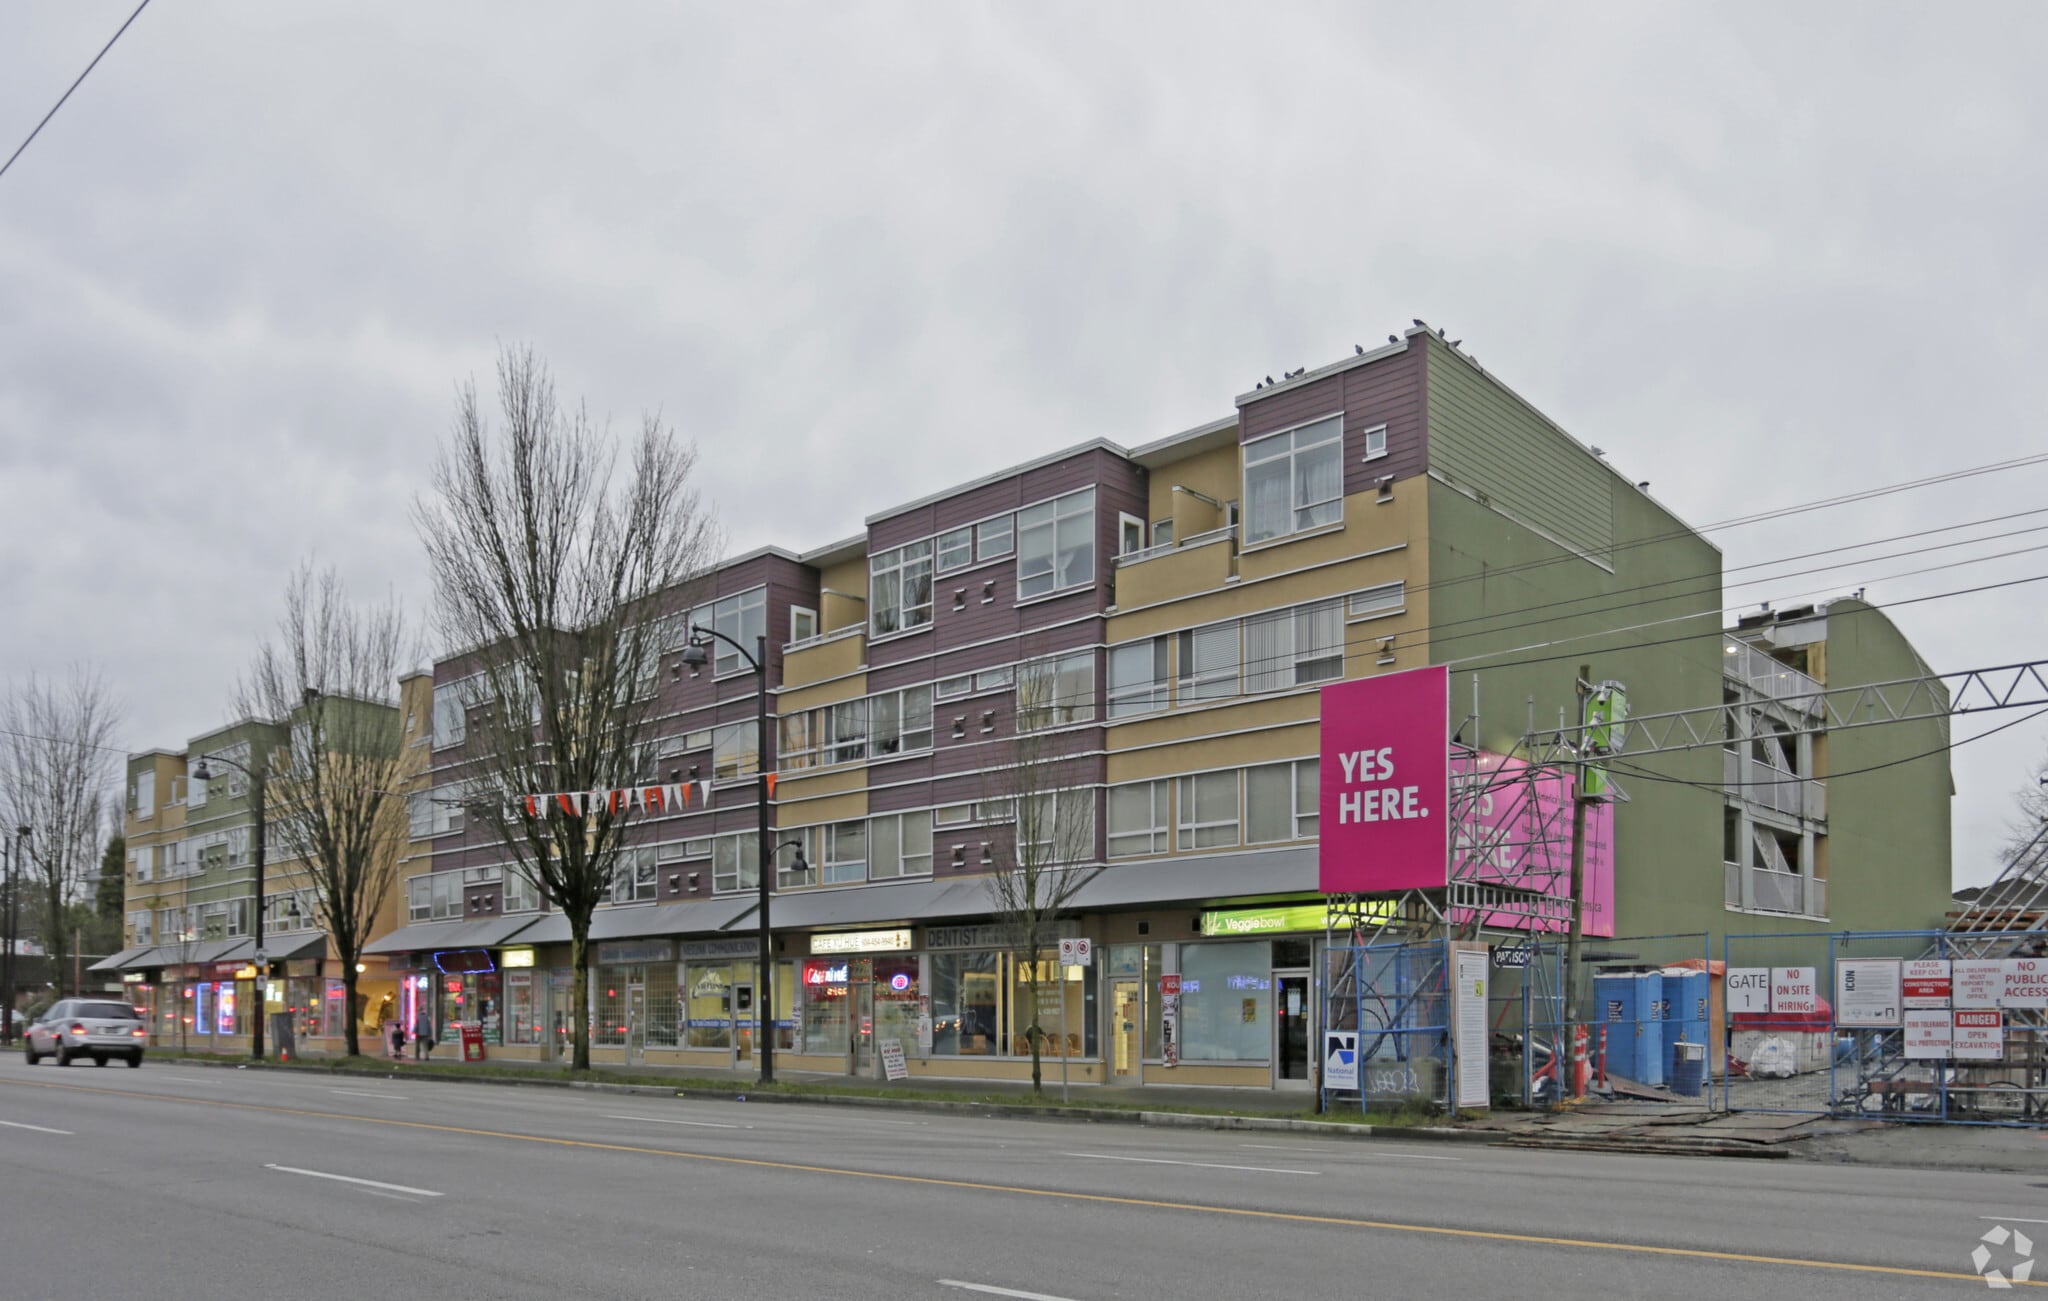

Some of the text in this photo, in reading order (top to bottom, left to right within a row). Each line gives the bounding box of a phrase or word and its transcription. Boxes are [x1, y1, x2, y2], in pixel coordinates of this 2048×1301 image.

[1338, 747, 1395, 784] YES
[1339, 785, 1430, 825] HERE.
[927, 928, 978, 947] DENTIST
[2017, 961, 2036, 972] NO
[1786, 969, 1799, 980] NO
[2005, 974, 2048, 985] PUBLIC
[1728, 974, 1767, 989] GATE
[1845, 970, 1855, 991] ICON
[1776, 985, 1810, 996] ON SITE
[2004, 987, 2048, 998] ACCESS
[1744, 994, 1750, 1008] 1
[1777, 1001, 1810, 1012] HIRING
[1959, 1014, 1997, 1025] DANGER
[1967, 1031, 1988, 1039] OPEN
[1906, 1039, 1950, 1047] FALL PROTECTION
[1327, 1067, 1354, 1075] National
